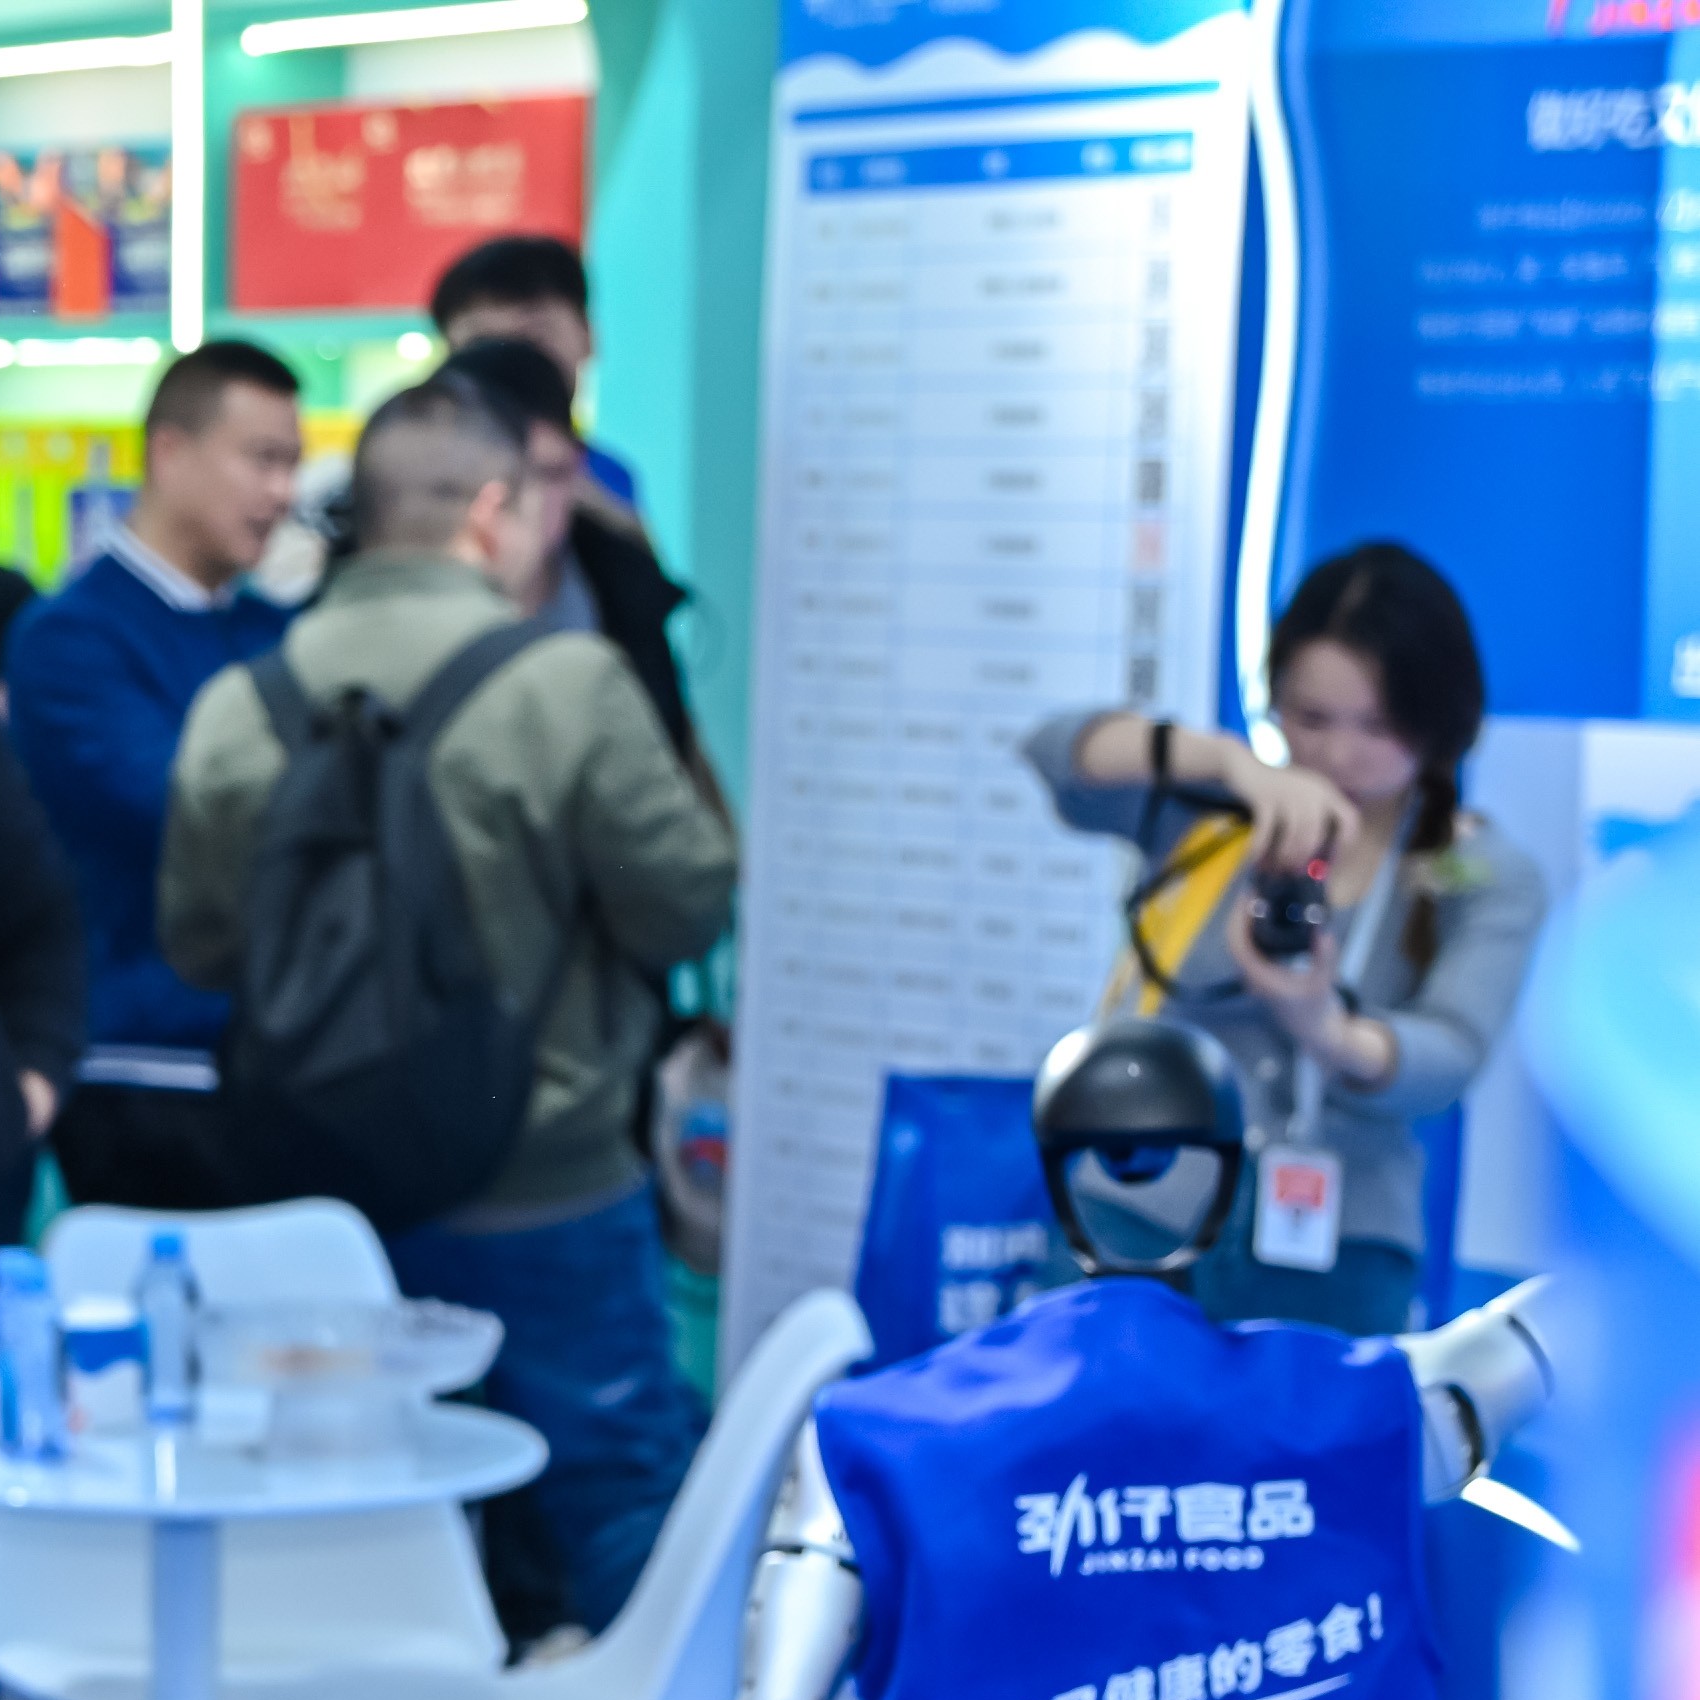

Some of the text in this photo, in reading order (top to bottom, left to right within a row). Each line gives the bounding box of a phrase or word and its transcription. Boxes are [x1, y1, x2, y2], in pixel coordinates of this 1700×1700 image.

[1014, 1473, 1315, 1577] 劲仔食品
[1079, 1546, 1265, 1576] JINZAI FOOD
